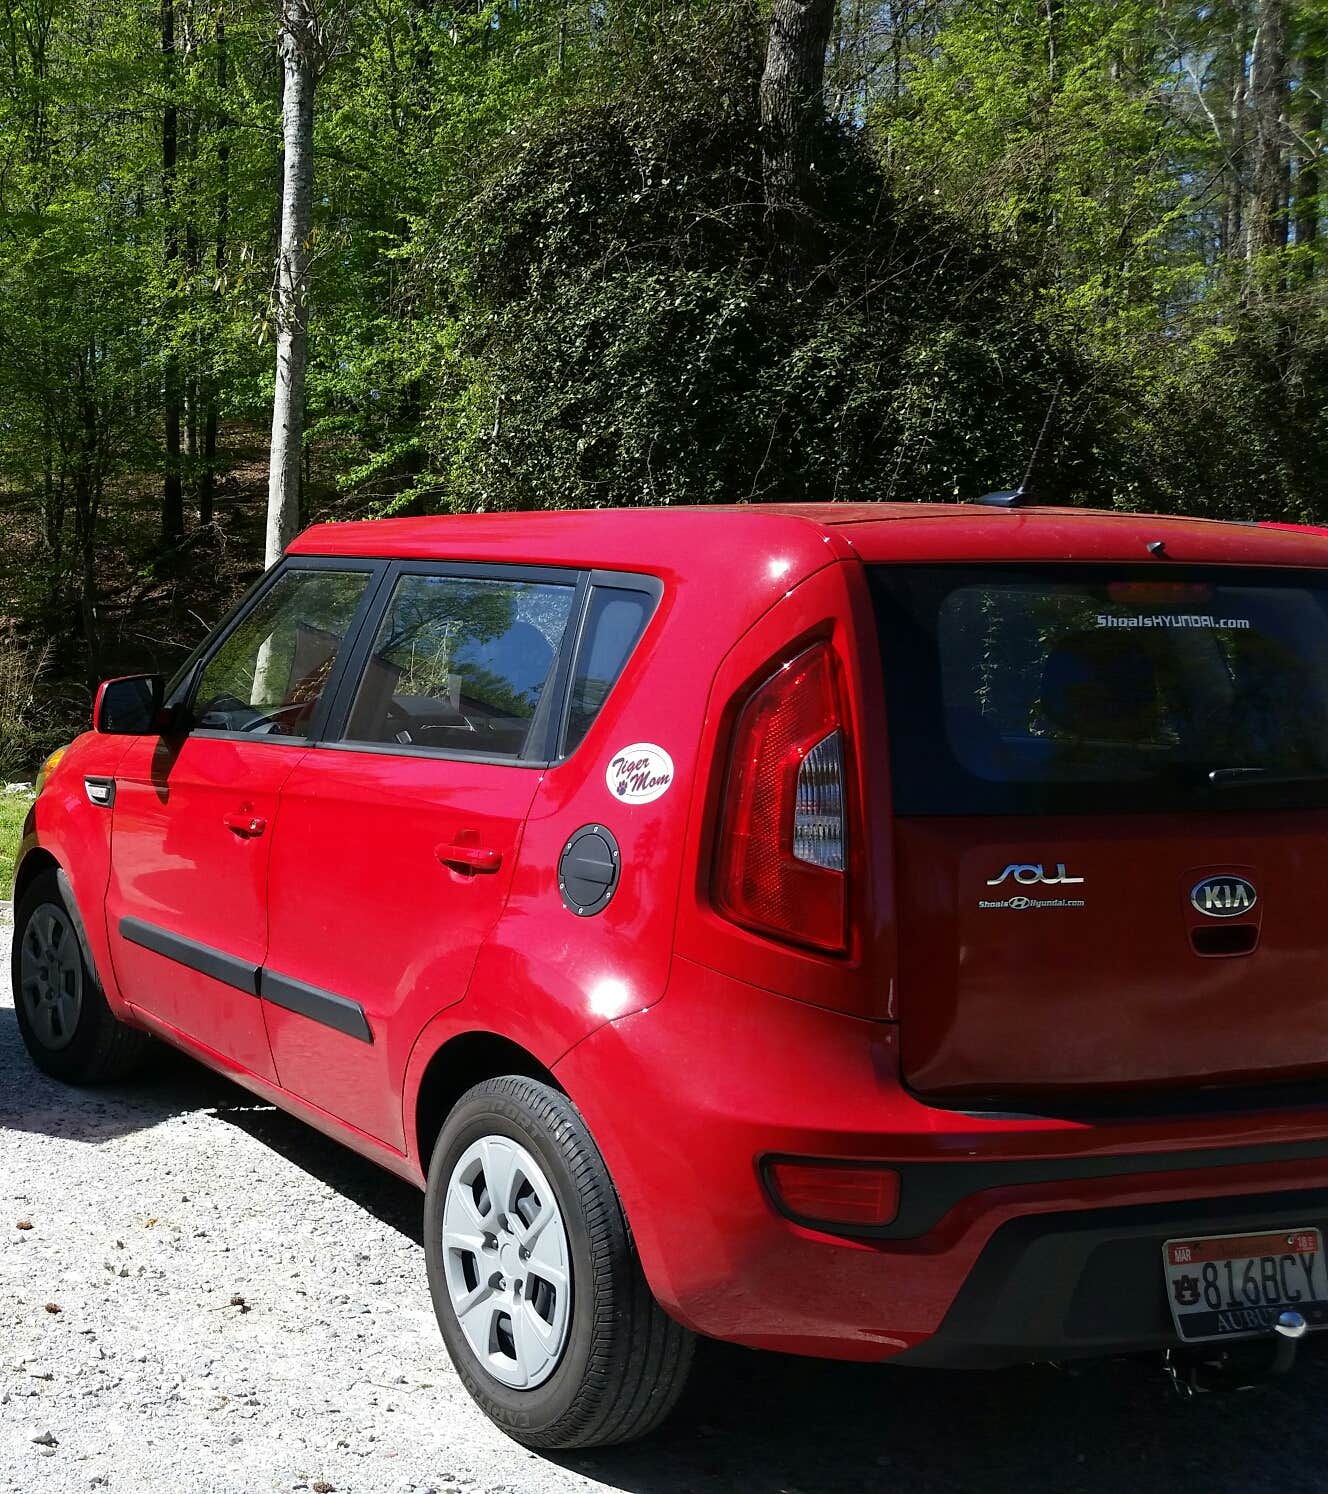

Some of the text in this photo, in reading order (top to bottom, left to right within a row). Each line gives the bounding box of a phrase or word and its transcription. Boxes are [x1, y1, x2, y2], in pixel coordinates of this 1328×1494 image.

[1097, 615, 1250, 629] ShoalsHYUNDAI.com
[612, 757, 650, 779] Tiger
[630, 770, 671, 793] Mom
[986, 863, 1085, 886] SOUL
[1203, 884, 1249, 909] KIA
[1174, 1248, 1192, 1263] MAR
[1202, 1253, 1316, 1310] 816BCY
